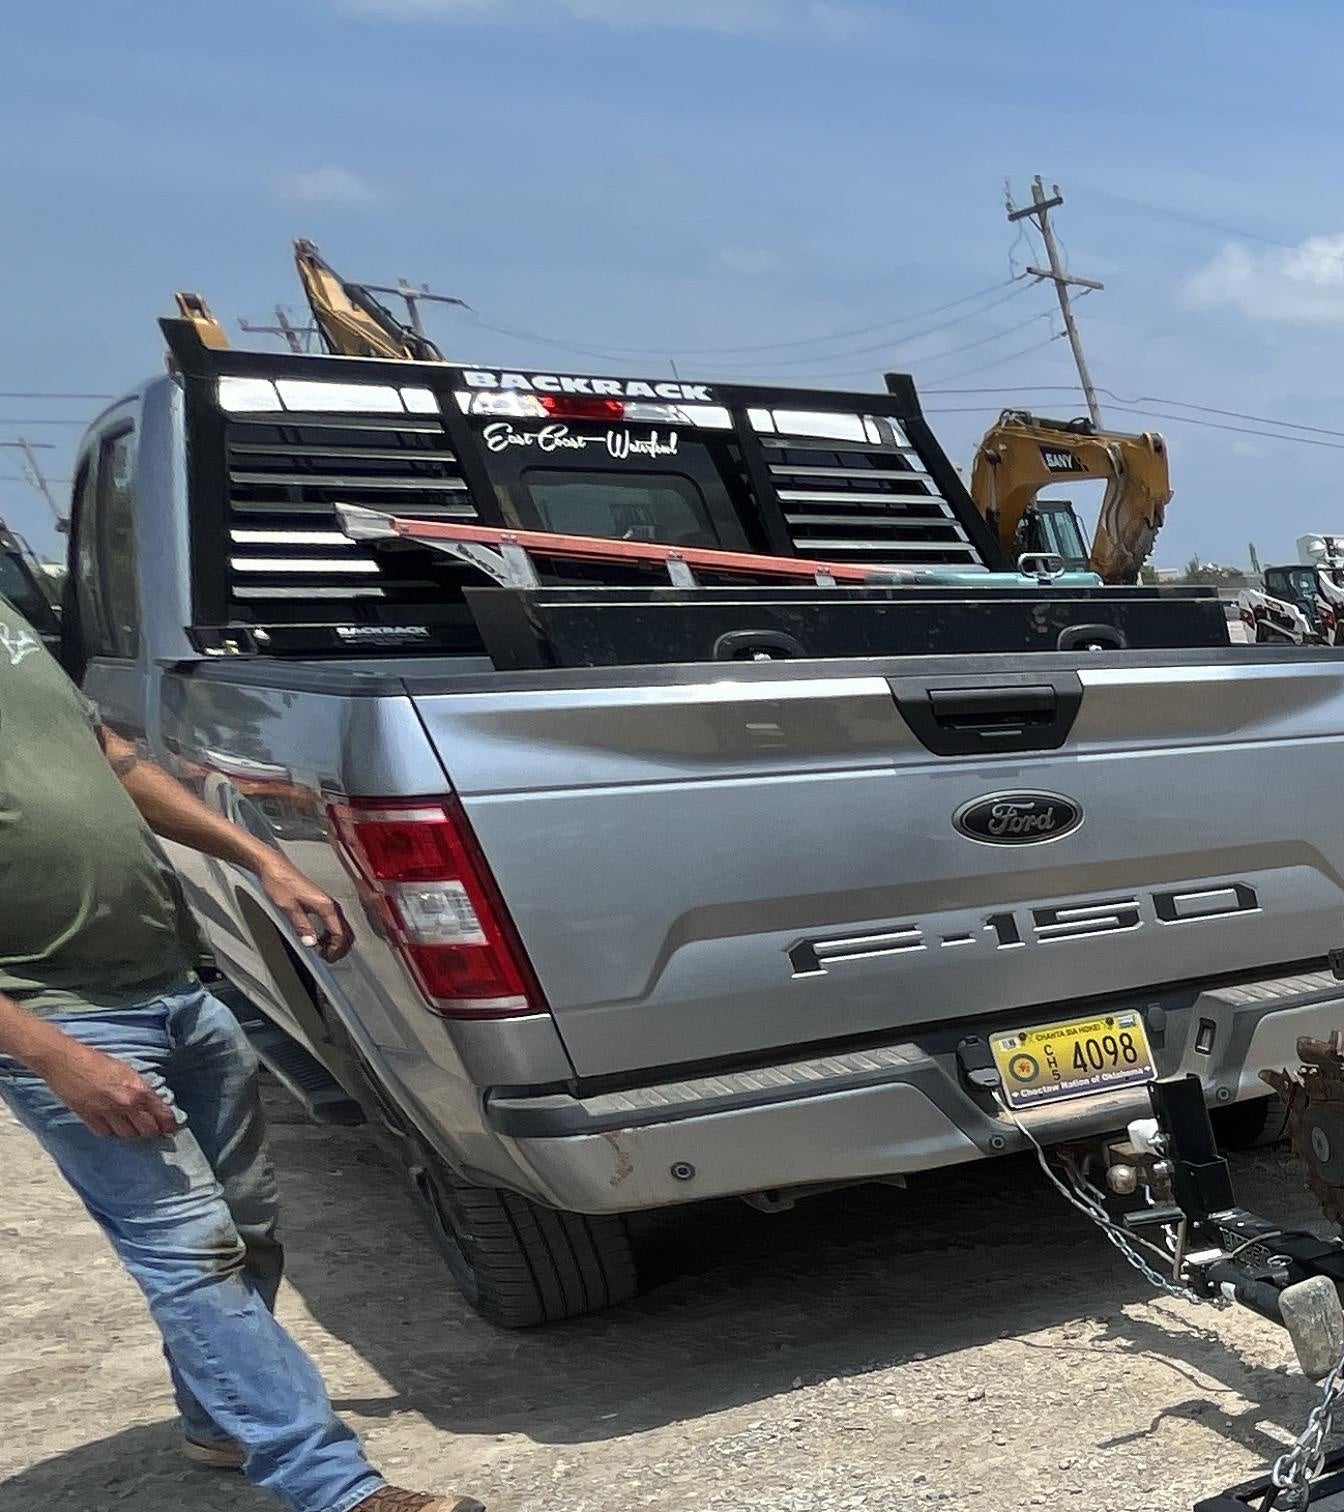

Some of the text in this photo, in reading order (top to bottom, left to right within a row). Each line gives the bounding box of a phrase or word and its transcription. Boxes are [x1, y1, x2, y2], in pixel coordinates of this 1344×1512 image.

[462, 370, 711, 401] BACKRACK
[483, 423, 537, 452] East
[537, 424, 588, 452] Coast
[1045, 453, 1073, 469] SANY
[987, 801, 1056, 835] Ford
[786, 881, 1263, 979] F-150
[1073, 1033, 1138, 1072] 4098
[1020, 1068, 1144, 1098] Choctaw Nation of Oklahoma
